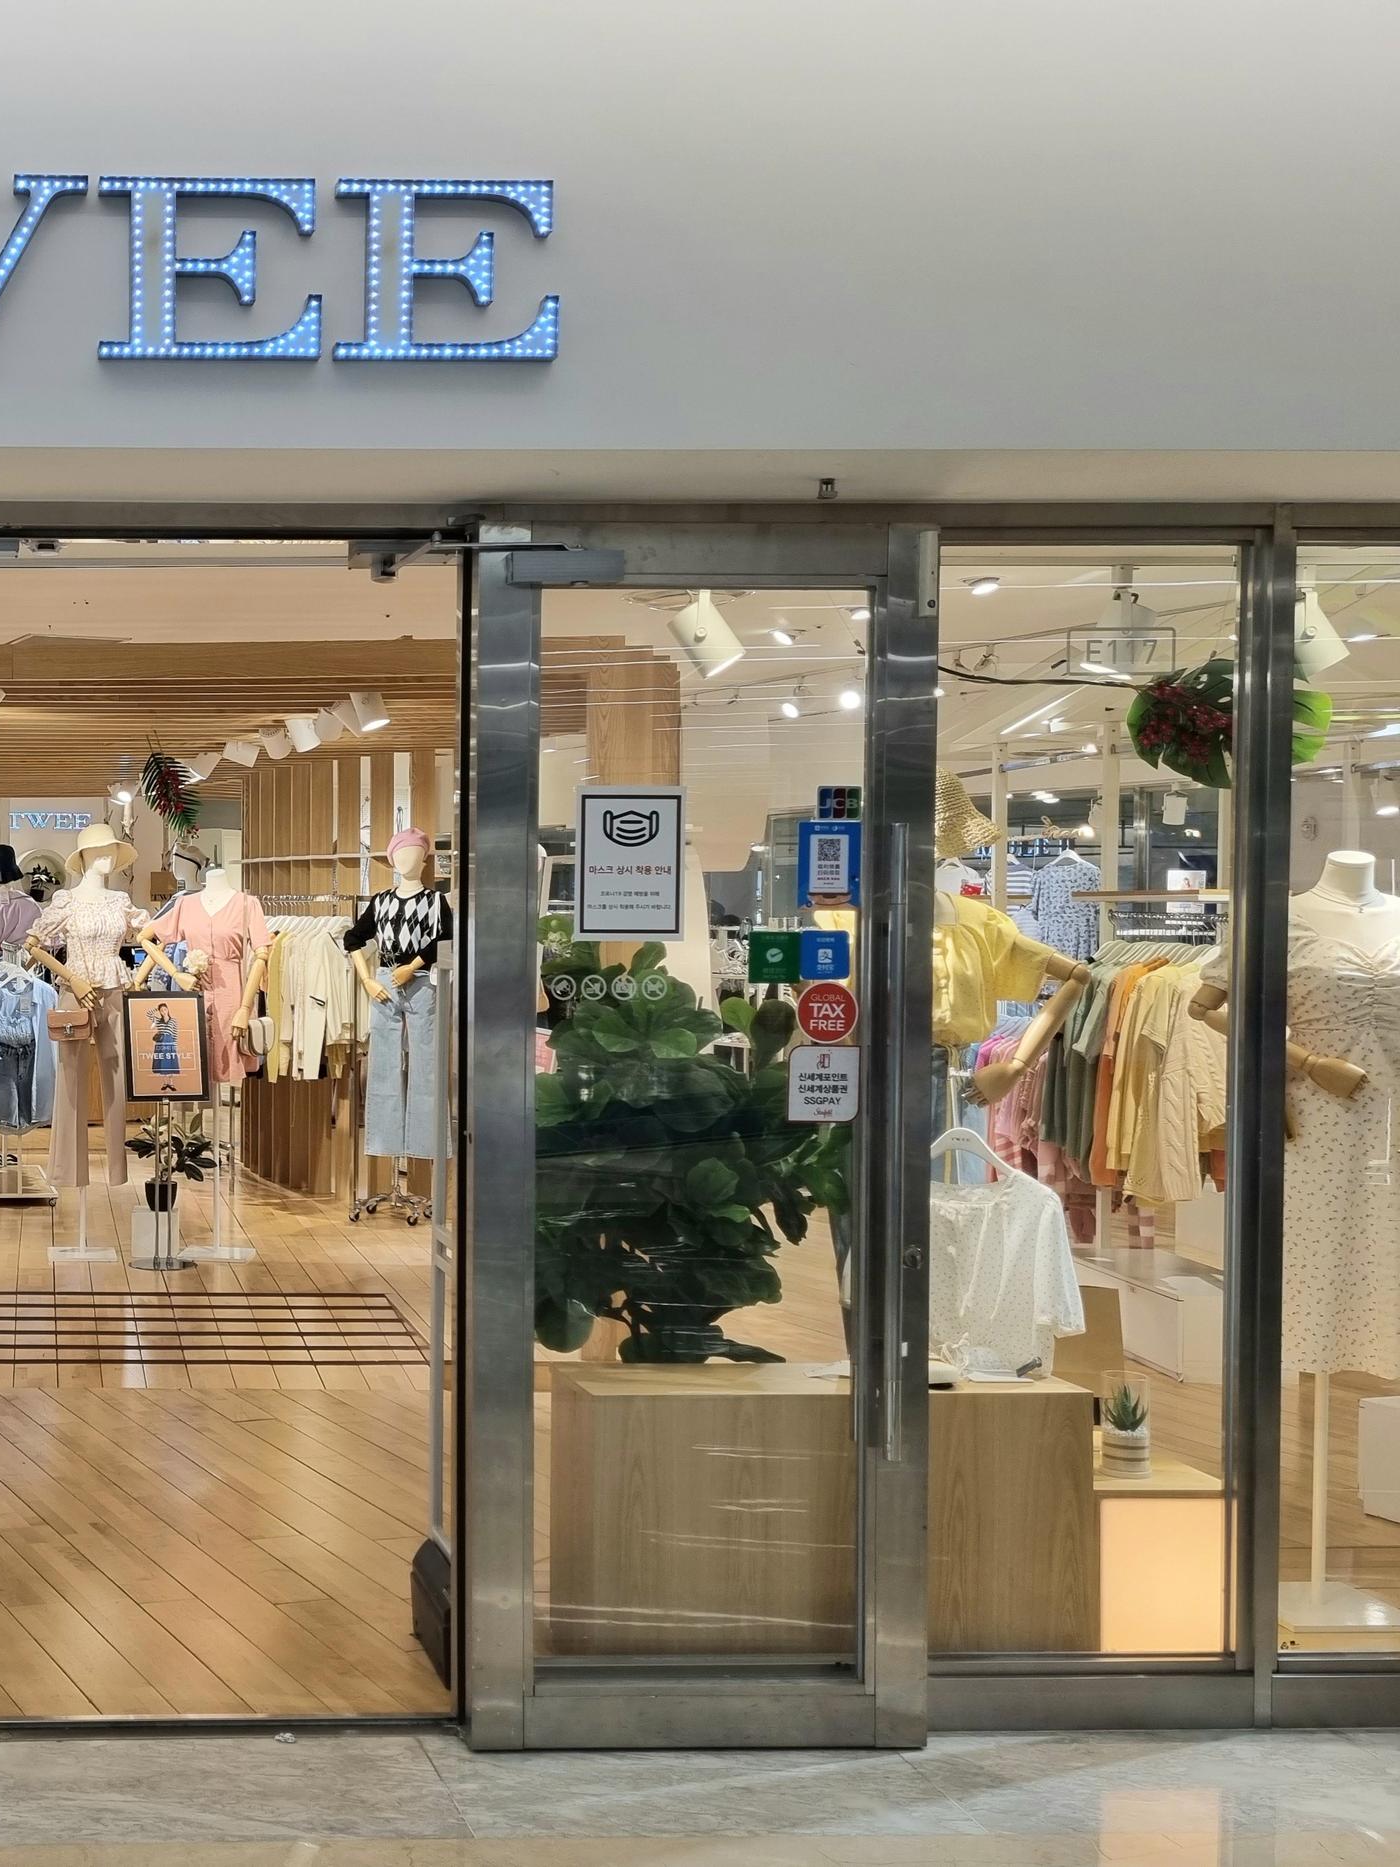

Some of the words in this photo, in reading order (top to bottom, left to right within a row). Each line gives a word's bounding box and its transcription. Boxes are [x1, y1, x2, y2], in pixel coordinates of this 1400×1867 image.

[1086, 639, 1158, 665] E117
[819, 798, 858, 809] JCB
[588, 865, 614, 875] 마스크
[616, 865, 633, 875] 상시
[635, 865, 652, 875] 착용
[654, 865, 672, 875] 안내
[810, 993, 844, 1002] GLOBAL
[809, 1003, 846, 1018] TAX
[809, 1020, 846, 1031] FREE
[798, 1072, 849, 1082] 신세계포인트
[803, 1096, 842, 1105] SSGPAY
